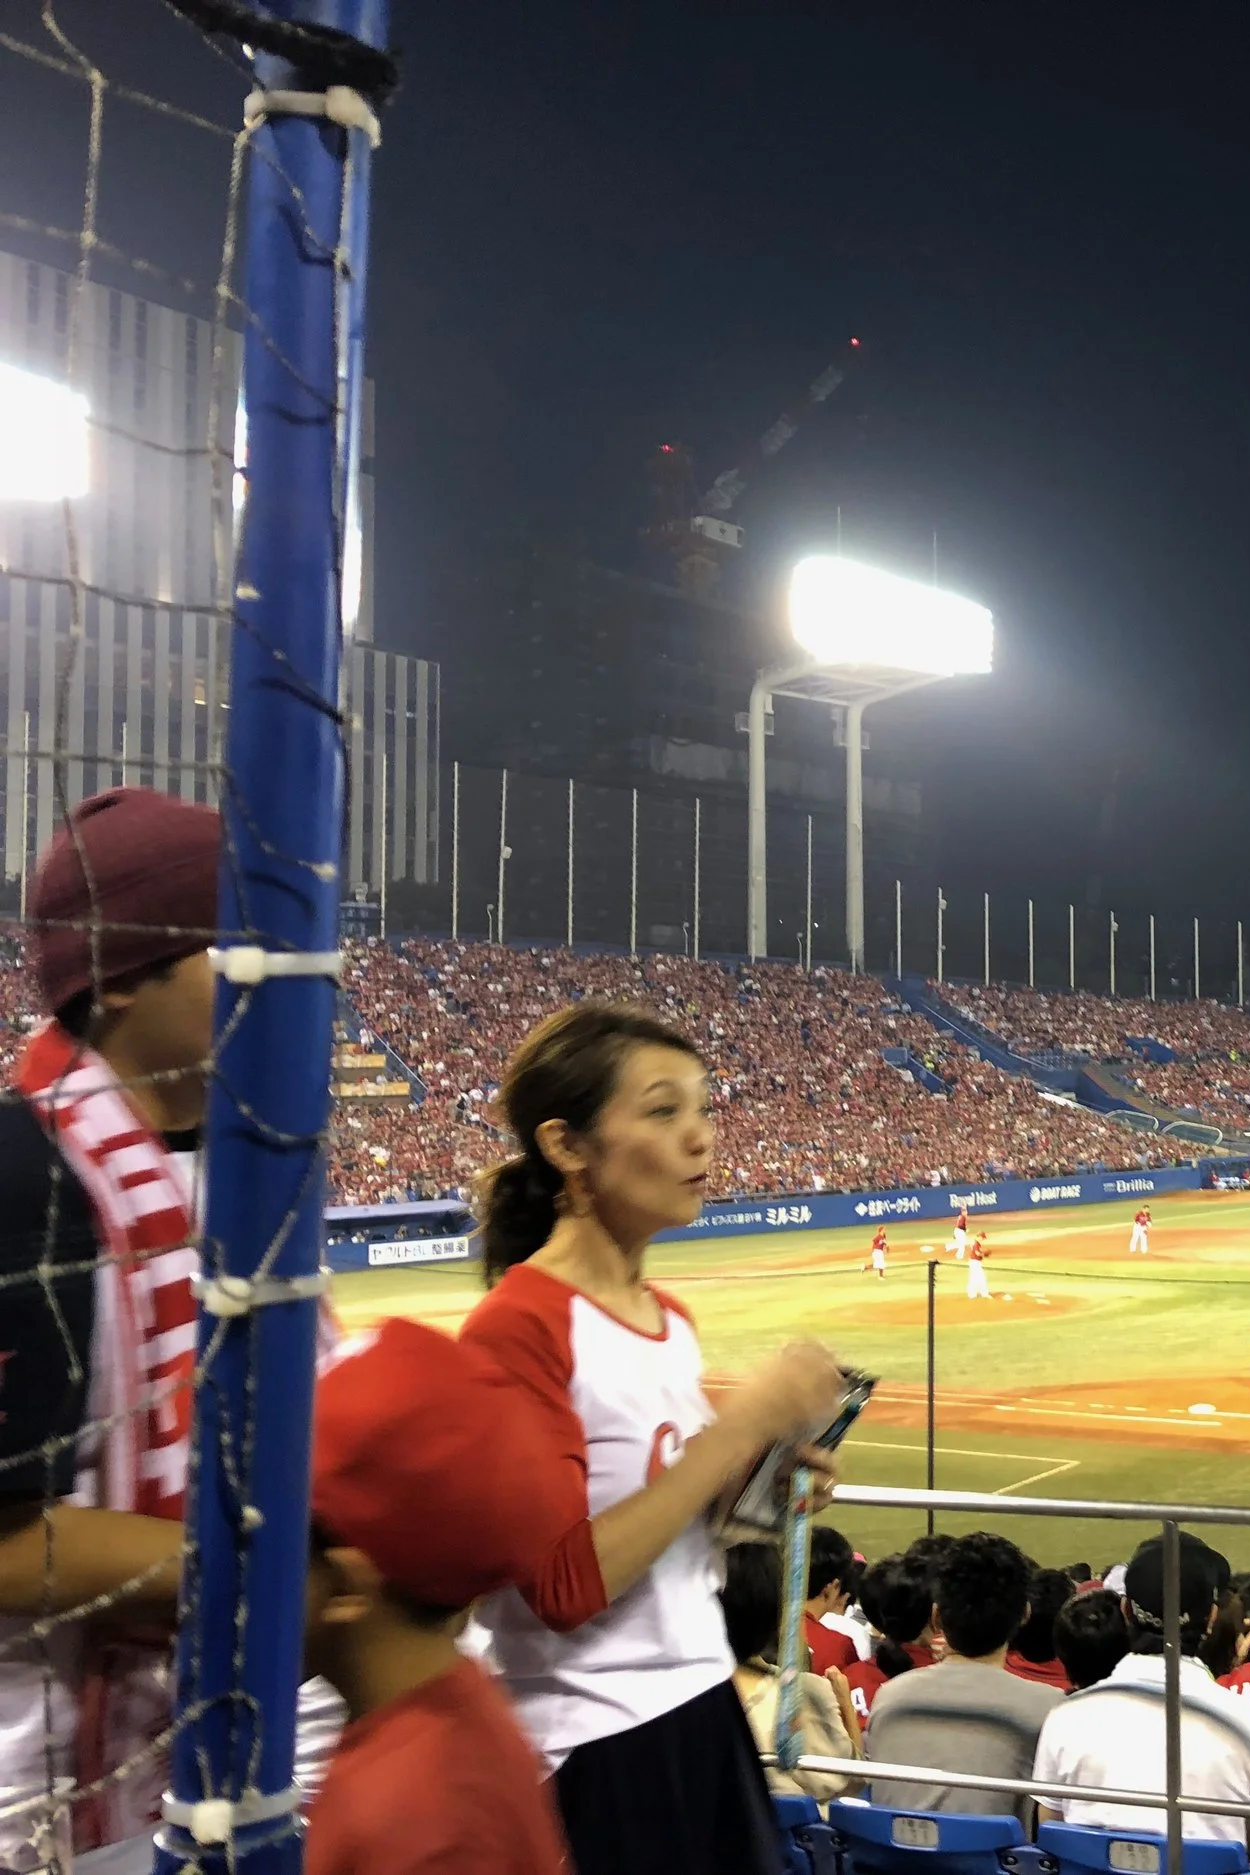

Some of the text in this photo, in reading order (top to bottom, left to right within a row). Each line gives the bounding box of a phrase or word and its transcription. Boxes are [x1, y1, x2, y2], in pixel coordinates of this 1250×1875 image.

[1115, 1179, 1154, 1193] Brillia
[766, 1205, 812, 1226] ミルミル
